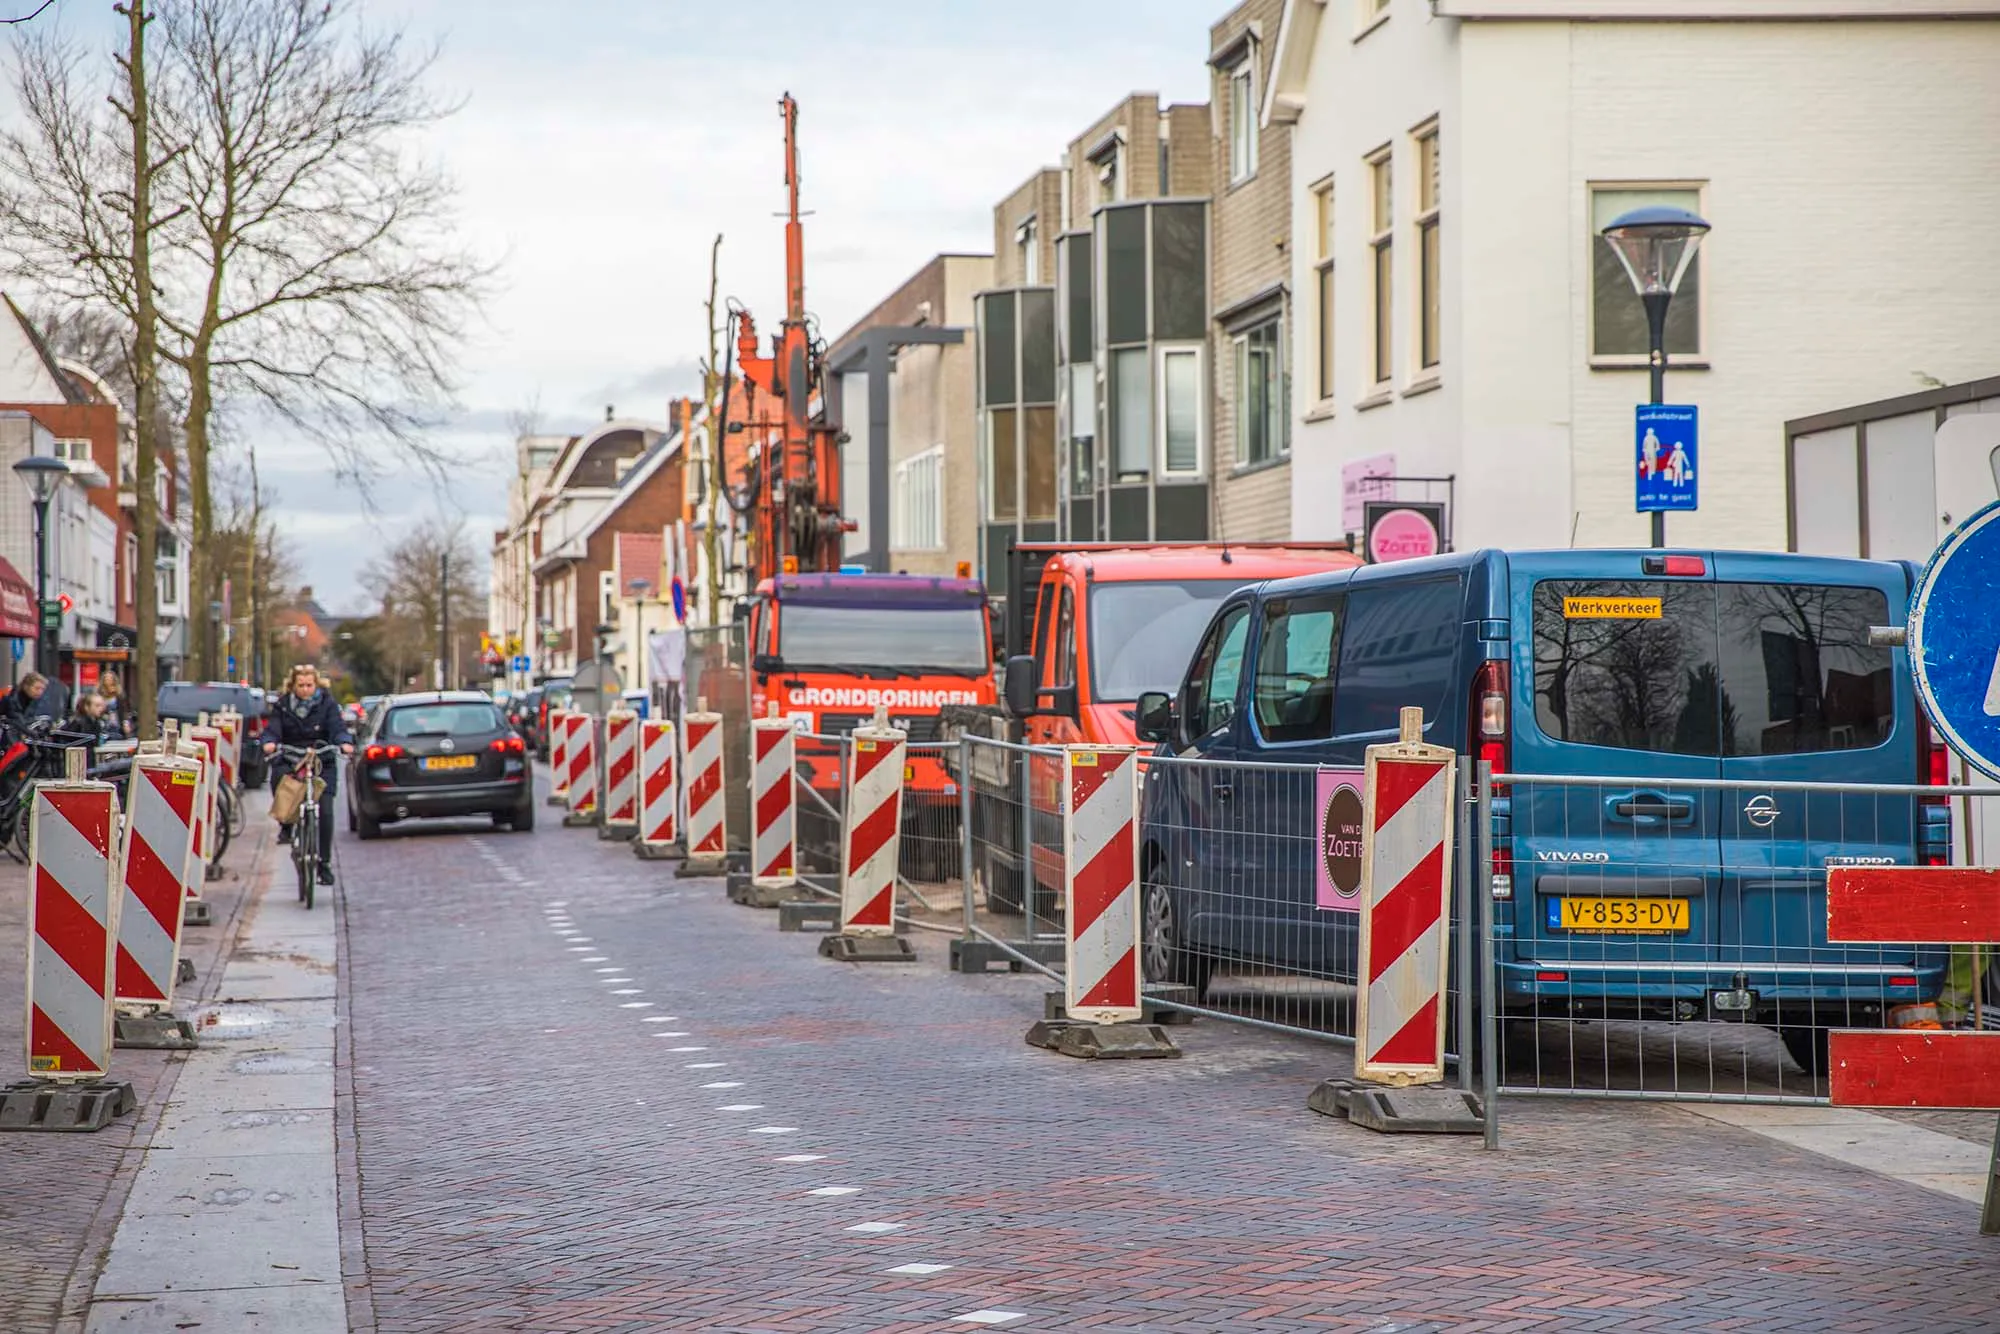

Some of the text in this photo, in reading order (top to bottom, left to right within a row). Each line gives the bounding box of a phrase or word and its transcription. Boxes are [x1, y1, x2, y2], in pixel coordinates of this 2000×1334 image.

[1567, 601, 1657, 614] Werkverkeer
[788, 687, 978, 706] GRONDBORINGEN
[857, 718, 911, 731] MN
[1340, 823, 1363, 835] VAN D
[1537, 851, 1609, 863] VIVARO
[1568, 901, 1681, 924] V-853-DV
